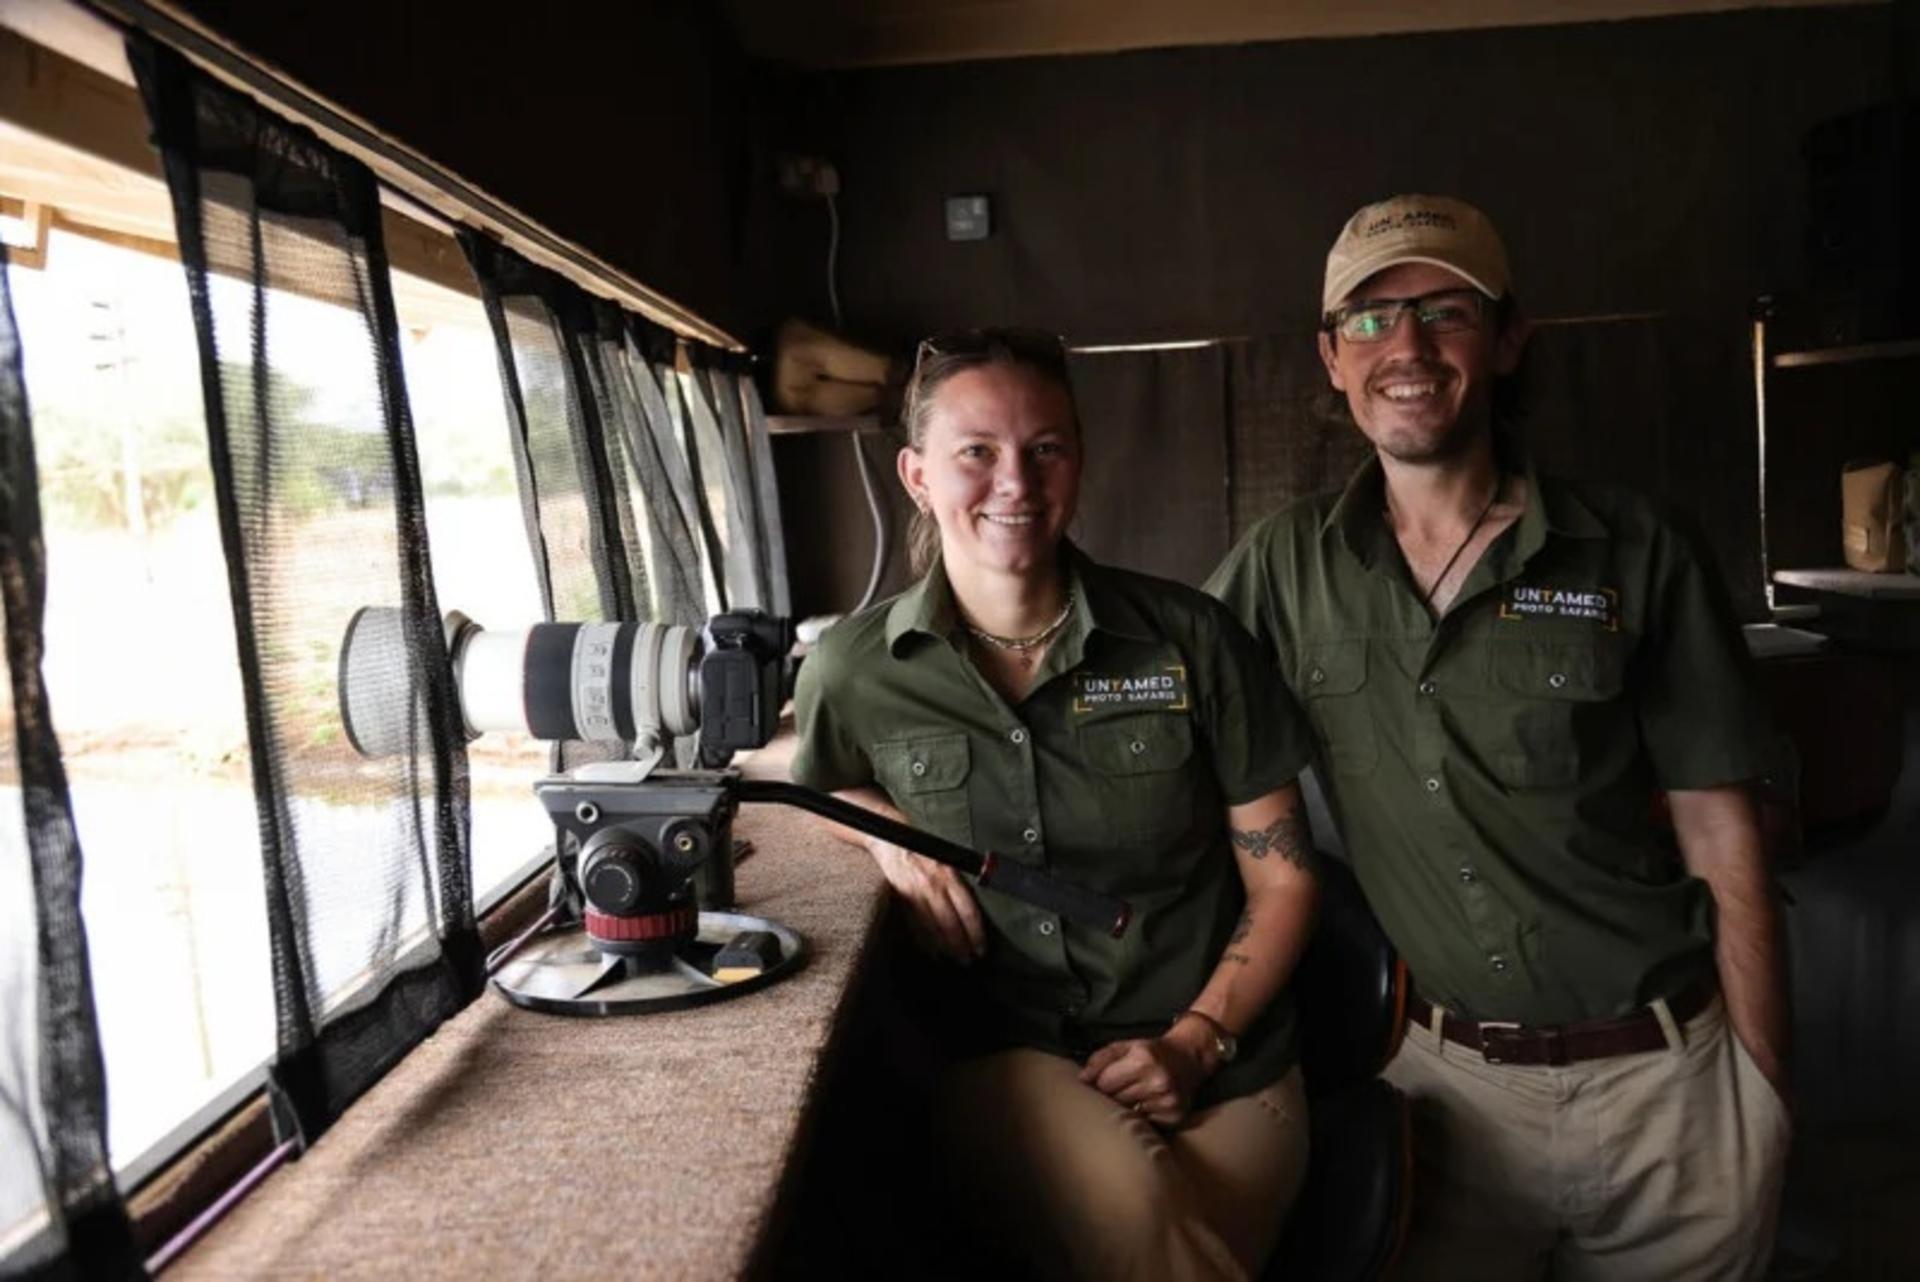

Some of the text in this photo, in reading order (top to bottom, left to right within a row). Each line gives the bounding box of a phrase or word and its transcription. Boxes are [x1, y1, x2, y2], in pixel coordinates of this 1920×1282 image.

[1513, 587, 1607, 608] UNTAMED
[1512, 602, 1554, 614] PHOTO
[1084, 676, 1175, 692] UNTAMED
[1084, 692, 1122, 703] PHOTO
